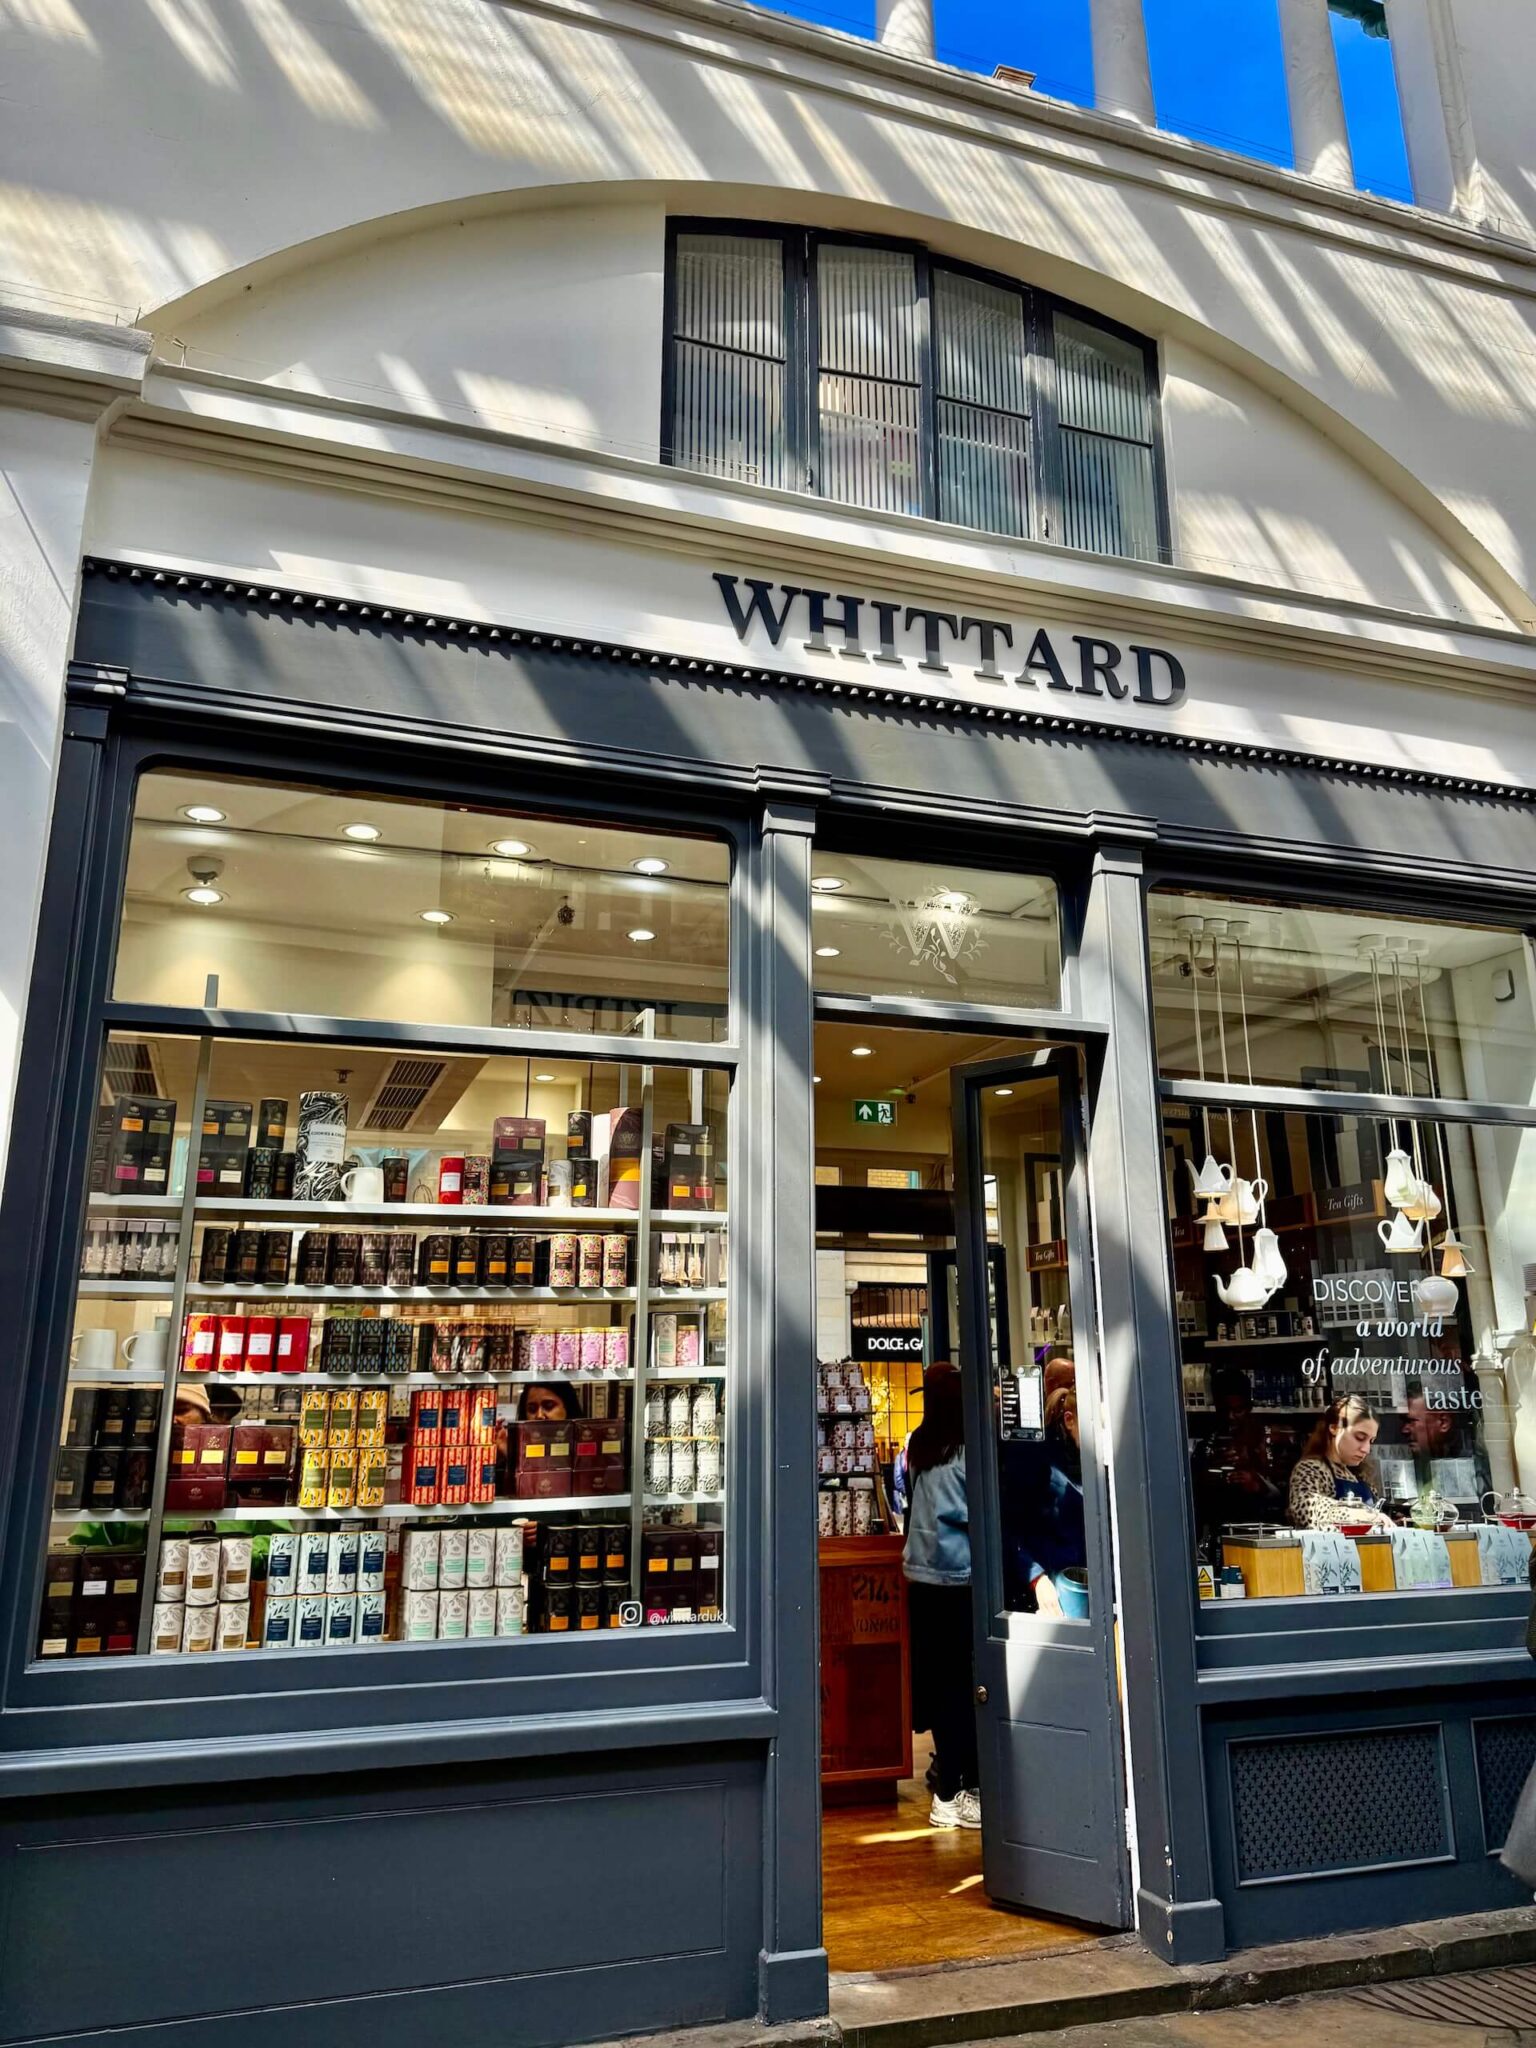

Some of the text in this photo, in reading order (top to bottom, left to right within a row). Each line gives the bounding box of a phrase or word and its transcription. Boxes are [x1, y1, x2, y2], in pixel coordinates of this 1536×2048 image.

[712, 572, 1186, 705] WHITTARD
[1327, 1193, 1364, 1211] Tea Gifts
[1312, 1279, 1424, 1303] DISCOVER
[1355, 1311, 1444, 1338] a world
[1301, 1347, 1462, 1383] of adventurous
[1422, 1385, 1497, 1410] tastes
[649, 1608, 724, 1626] @wharduk
